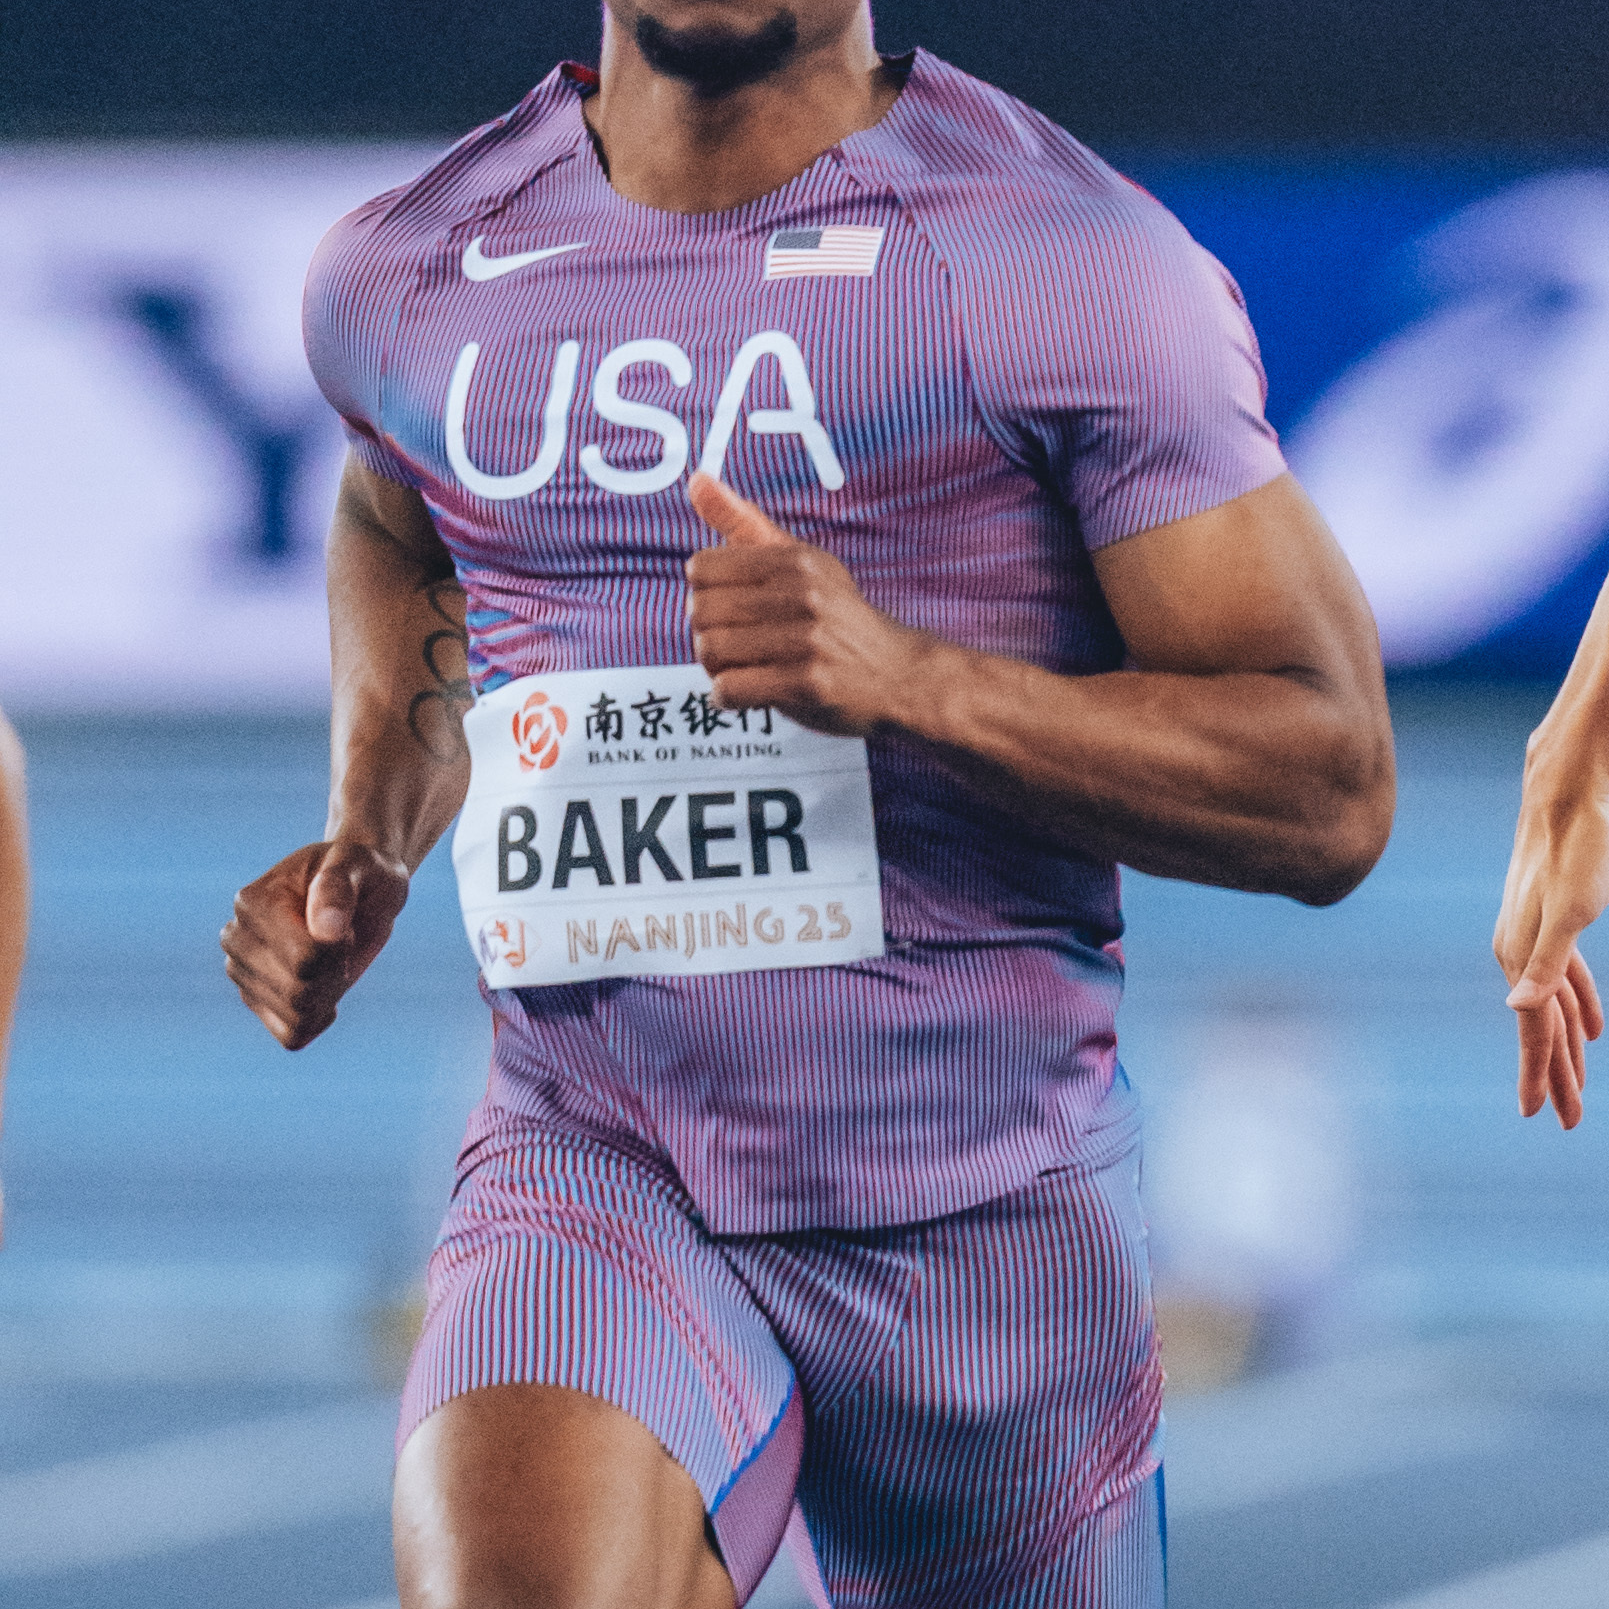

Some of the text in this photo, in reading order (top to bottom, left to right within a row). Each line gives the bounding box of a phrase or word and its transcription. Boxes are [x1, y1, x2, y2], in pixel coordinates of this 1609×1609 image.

[445, 330, 846, 501] USA
[587, 743, 782, 764] BANK OF NANJING
[497, 788, 811, 894] BAKER
[565, 901, 852, 965] NANJING 25
